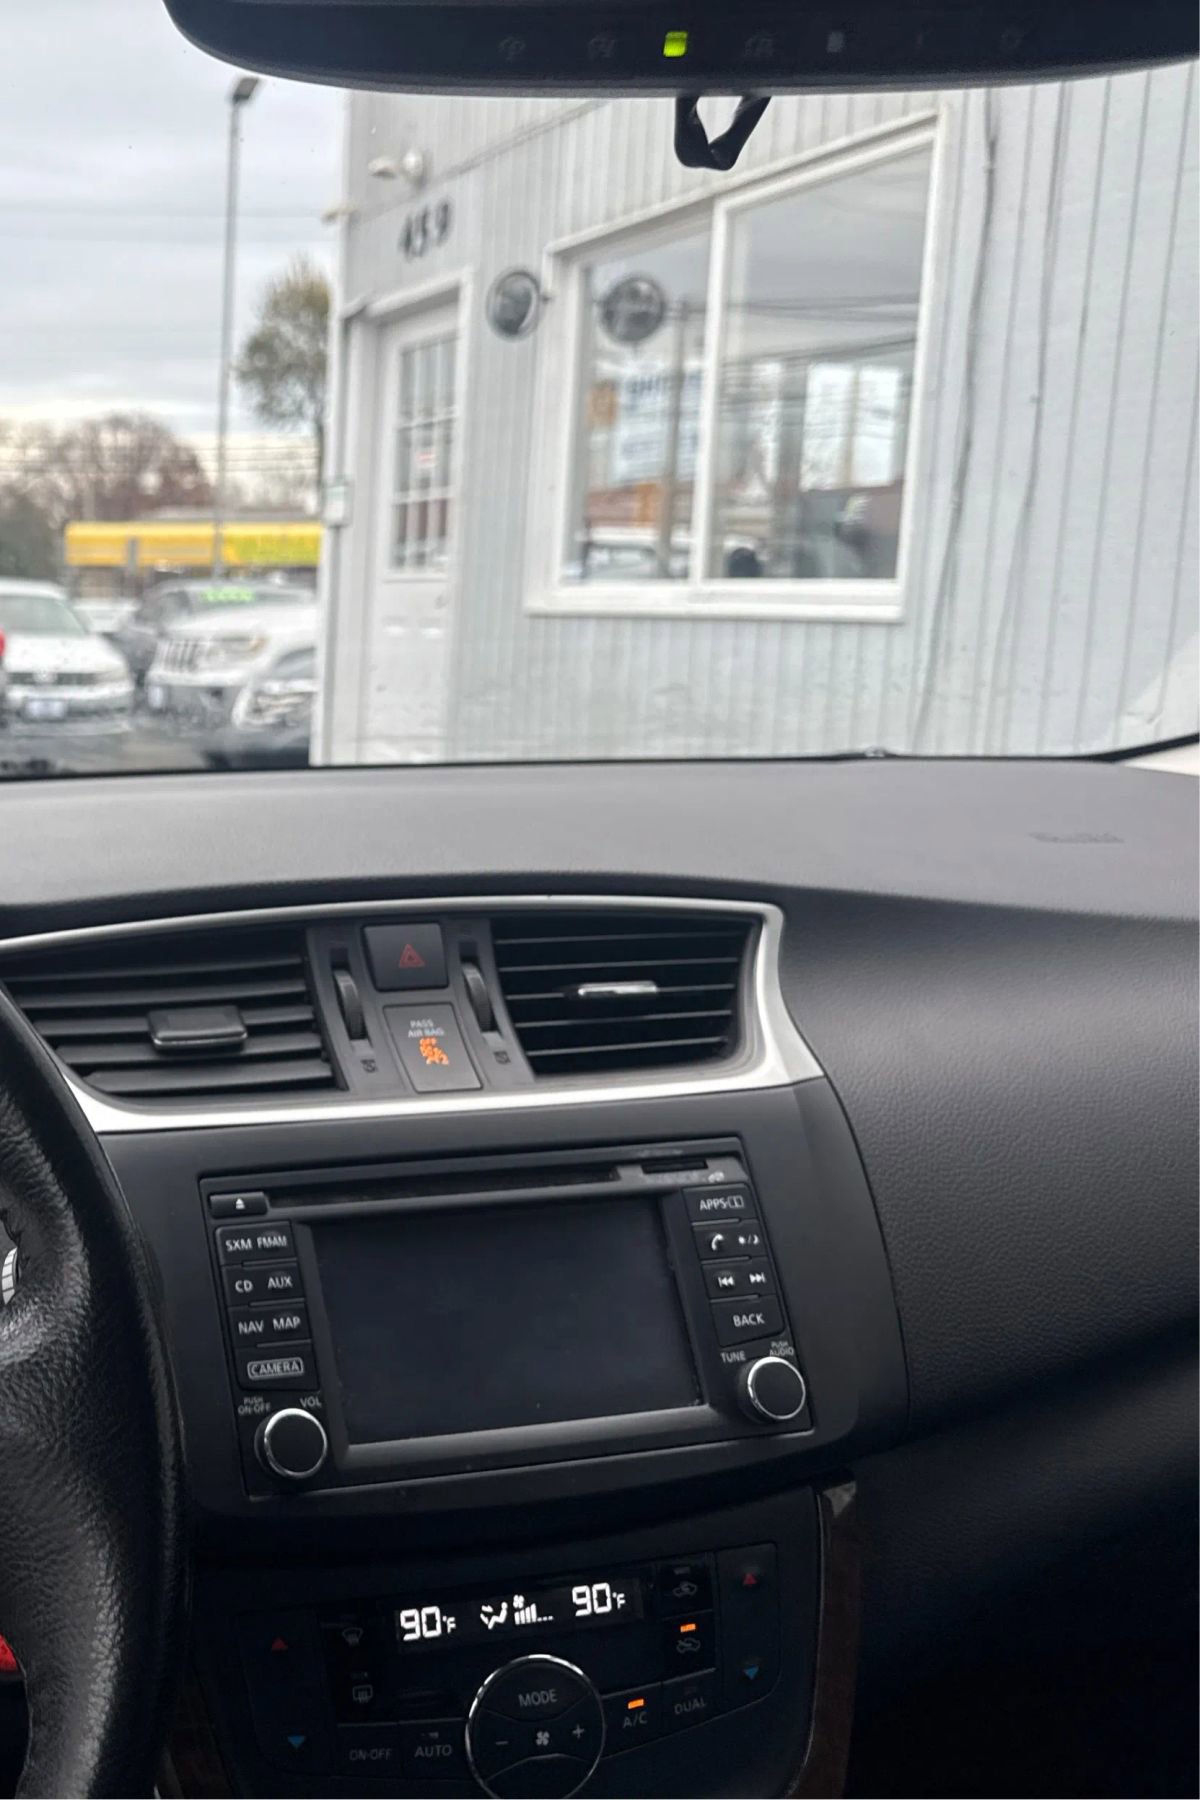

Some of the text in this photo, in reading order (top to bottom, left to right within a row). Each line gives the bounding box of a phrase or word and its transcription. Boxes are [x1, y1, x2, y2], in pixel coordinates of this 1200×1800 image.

[225, 1237, 252, 1252] SXM
[235, 1279, 253, 1293] CD
[267, 1275, 293, 1289] AUX
[238, 1319, 264, 1335] NAV
[273, 1315, 301, 1330] MAP
[733, 1312, 765, 1327] BACK
[720, 1350, 746, 1363] TUNE
[250, 1359, 300, 1376] CAMERA
[299, 1395, 322, 1408] VOL
[518, 1689, 558, 1707] MODE
[674, 1697, 707, 1715] DUAL
[623, 1711, 648, 1728] A/C
[414, 1744, 453, 1758] AUTO
